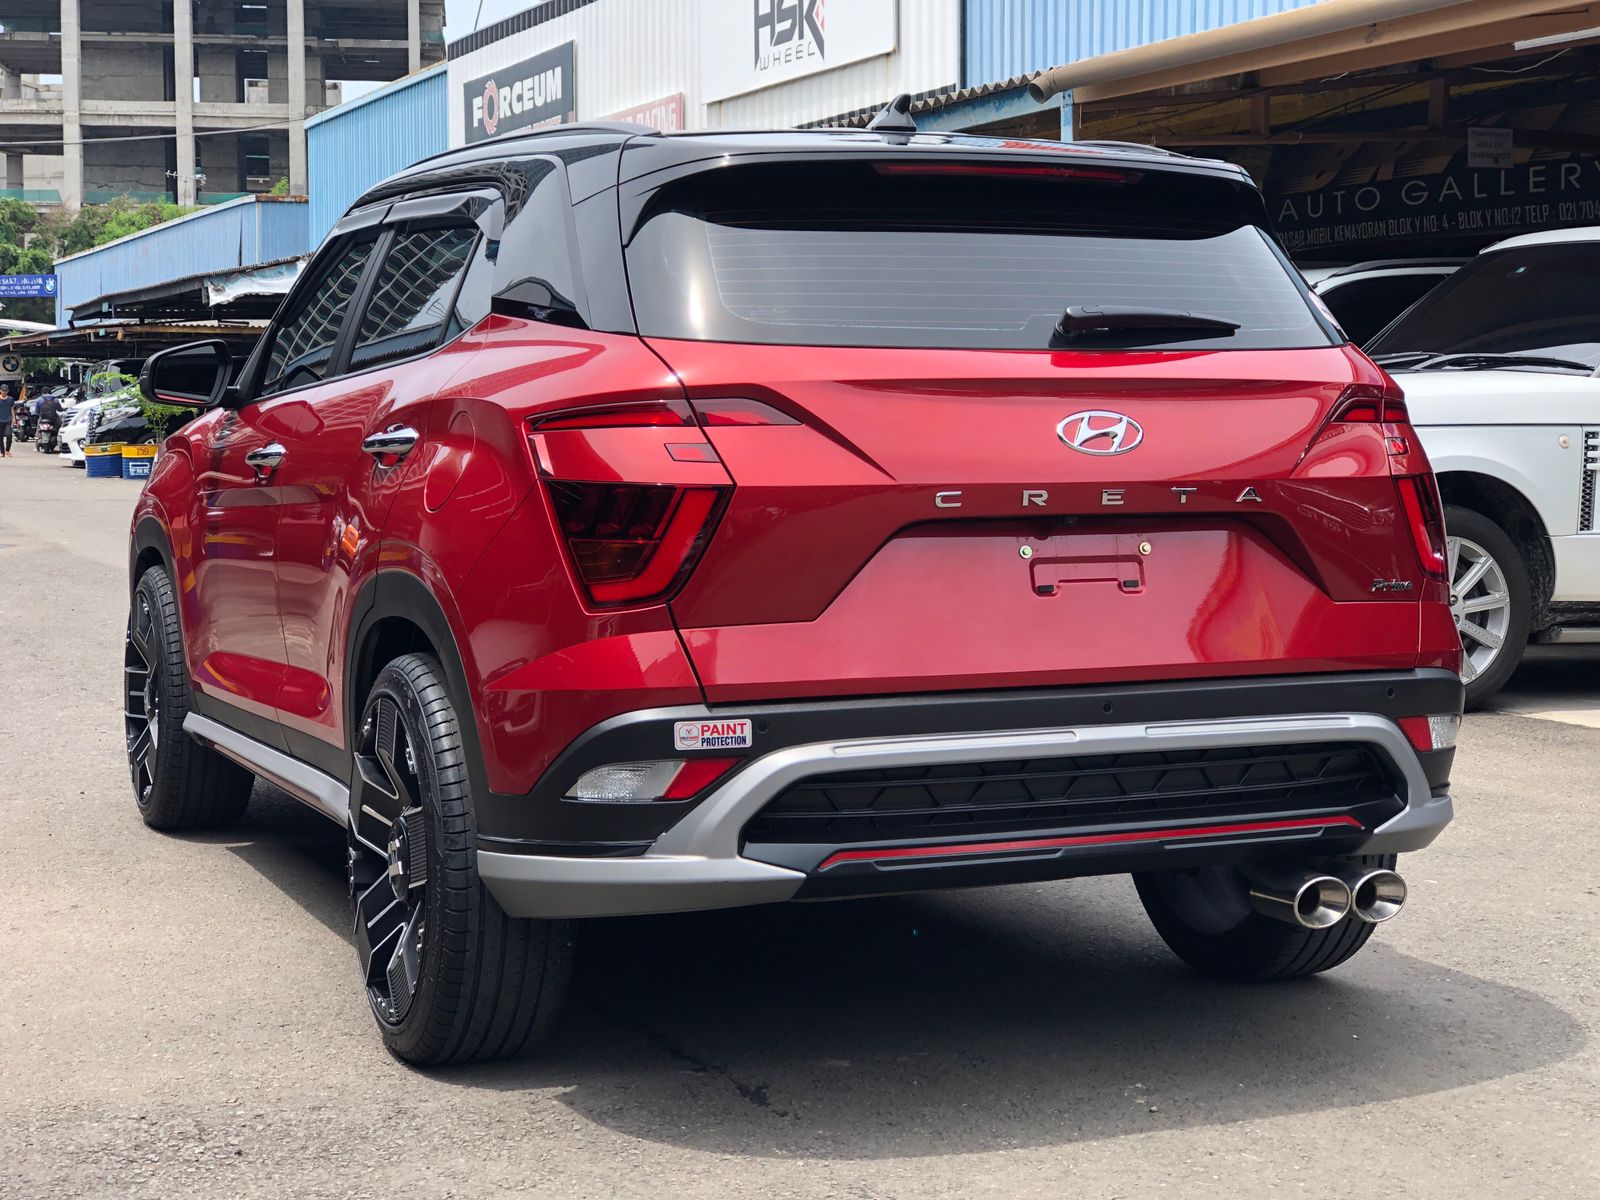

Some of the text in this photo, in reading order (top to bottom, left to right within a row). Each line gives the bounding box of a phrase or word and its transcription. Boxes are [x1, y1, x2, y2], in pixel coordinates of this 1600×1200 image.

[754, 0, 824, 71] HSK
[760, 41, 815, 71] WHEEL
[473, 66, 562, 135] FORCEUM
[1278, 187, 1380, 222] AUTO
[1307, 227, 1333, 246] MOBIL
[1334, 220, 1386, 241] KEMAYORAN
[1388, 216, 1413, 236] BLOK
[1414, 216, 1421, 233] Y
[1442, 213, 1449, 230] 4
[1458, 210, 1484, 229] BLOK
[1485, 208, 1492, 227] Y
[1558, 202, 1577, 221] 021
[935, 486, 1263, 508] CRETA
[701, 723, 747, 737] PAINT
[701, 735, 747, 747] PROTECTION
